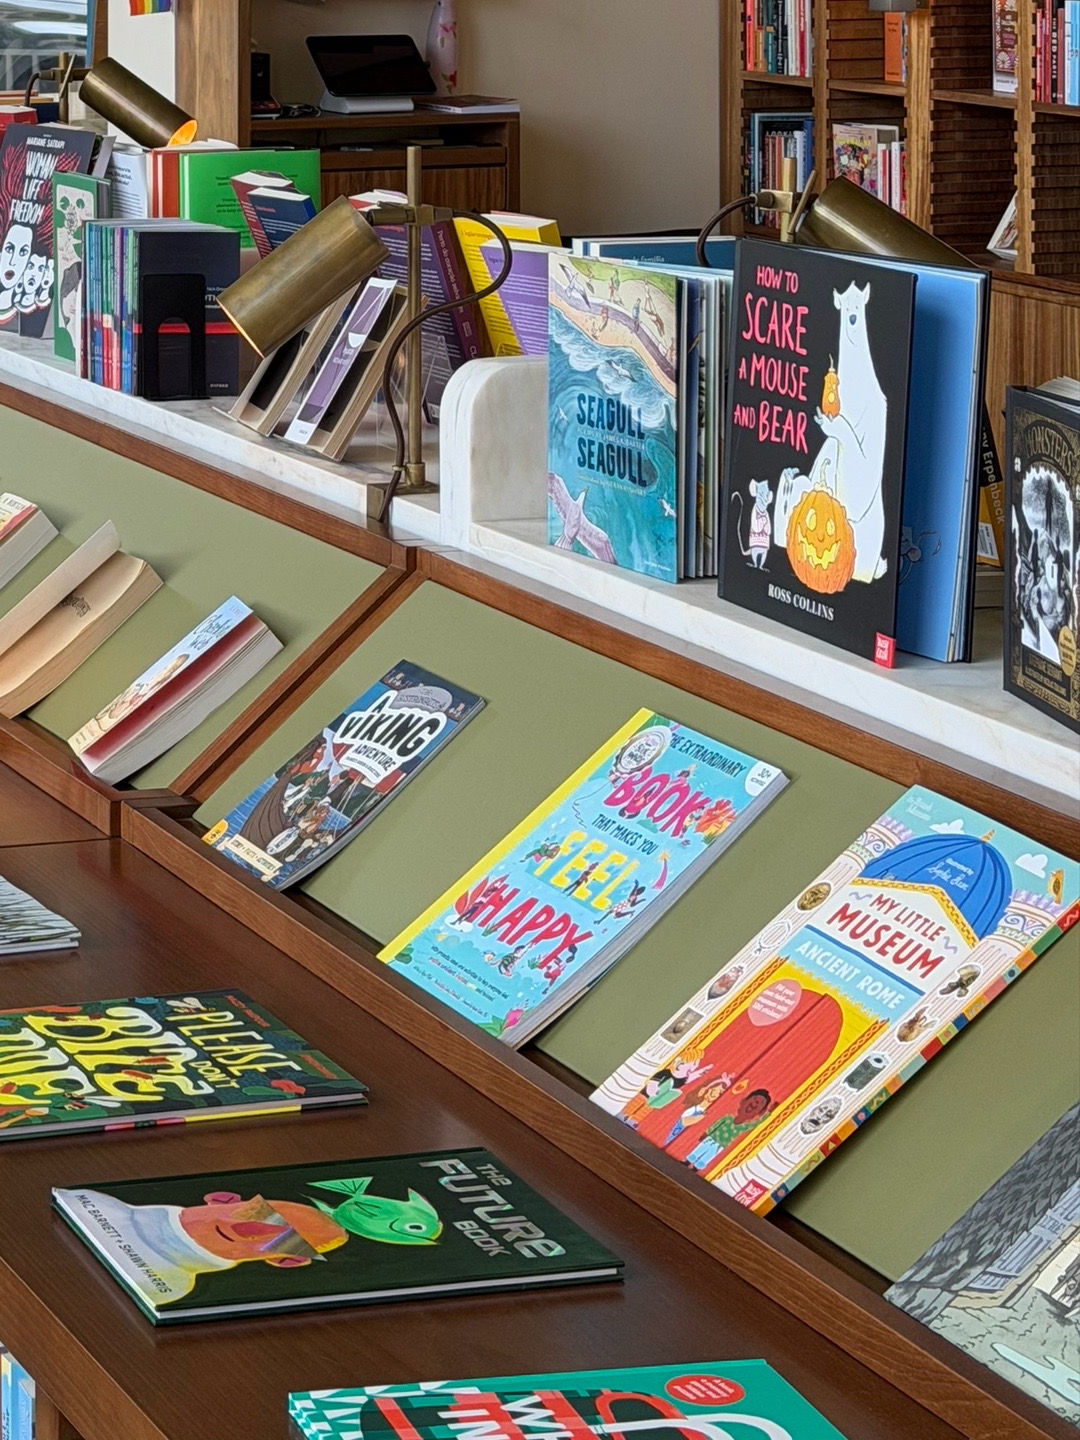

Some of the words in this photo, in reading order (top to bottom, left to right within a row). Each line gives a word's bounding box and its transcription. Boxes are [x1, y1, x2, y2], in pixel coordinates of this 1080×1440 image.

[26, 137, 46, 147] MARJANE
[47, 139, 66, 149] SATRAPI
[26, 151, 57, 178] WOMAN
[22, 178, 44, 200] LIFE
[10, 199, 46, 225] FREEDOM
[437, 230, 446, 248] Perto
[442, 248, 448, 257] do
[444, 257, 456, 281] coração
[756, 265, 782, 290] HOW
[785, 271, 799, 293] TO
[742, 292, 809, 356] SCARE
[739, 357, 747, 380] A
[750, 352, 809, 401] MOUSE
[577, 393, 645, 439] SEAGULL
[734, 404, 756, 429] AND
[758, 400, 809, 454] BEAR
[577, 437, 646, 486] SEAGULL
[1025, 425, 1075, 469] MONSTERS
[983, 450, 1006, 526] Erpenbeck
[768, 583, 791, 604] ROSS
[793, 594, 834, 621] COLLINS
[371, 695, 391, 714] A
[341, 712, 440, 757] VIKING
[670, 733, 682, 750] THE
[680, 739, 747, 778] EXTRAORDINARY
[352, 743, 396, 772] ADVENTURE
[604, 764, 707, 839] BOOK
[591, 813, 613, 832] THAT
[613, 822, 640, 845] MAKES
[638, 837, 659, 857] YOU
[534, 830, 640, 912] FEEL
[477, 883, 593, 970] HAPPY
[872, 894, 897, 916] MY
[895, 901, 946, 942] LITTLE
[828, 903, 946, 980] MUSEUM
[795, 939, 859, 985] ANCIENT
[856, 971, 906, 1011] ROME
[23, 1006, 215, 1101] BITE
[165, 1011, 302, 1076] PLEASE
[189, 1060, 240, 1090] DON'T
[476, 1164, 512, 1187] THE
[76, 1193, 97, 1211] MAC
[421, 1158, 566, 1260] FUTURE
[86, 1206, 122, 1243] BARNETT
[453, 1220, 512, 1258] BOOK
[122, 1242, 148, 1271] SHAWN
[139, 1264, 172, 1294] HARRIS
